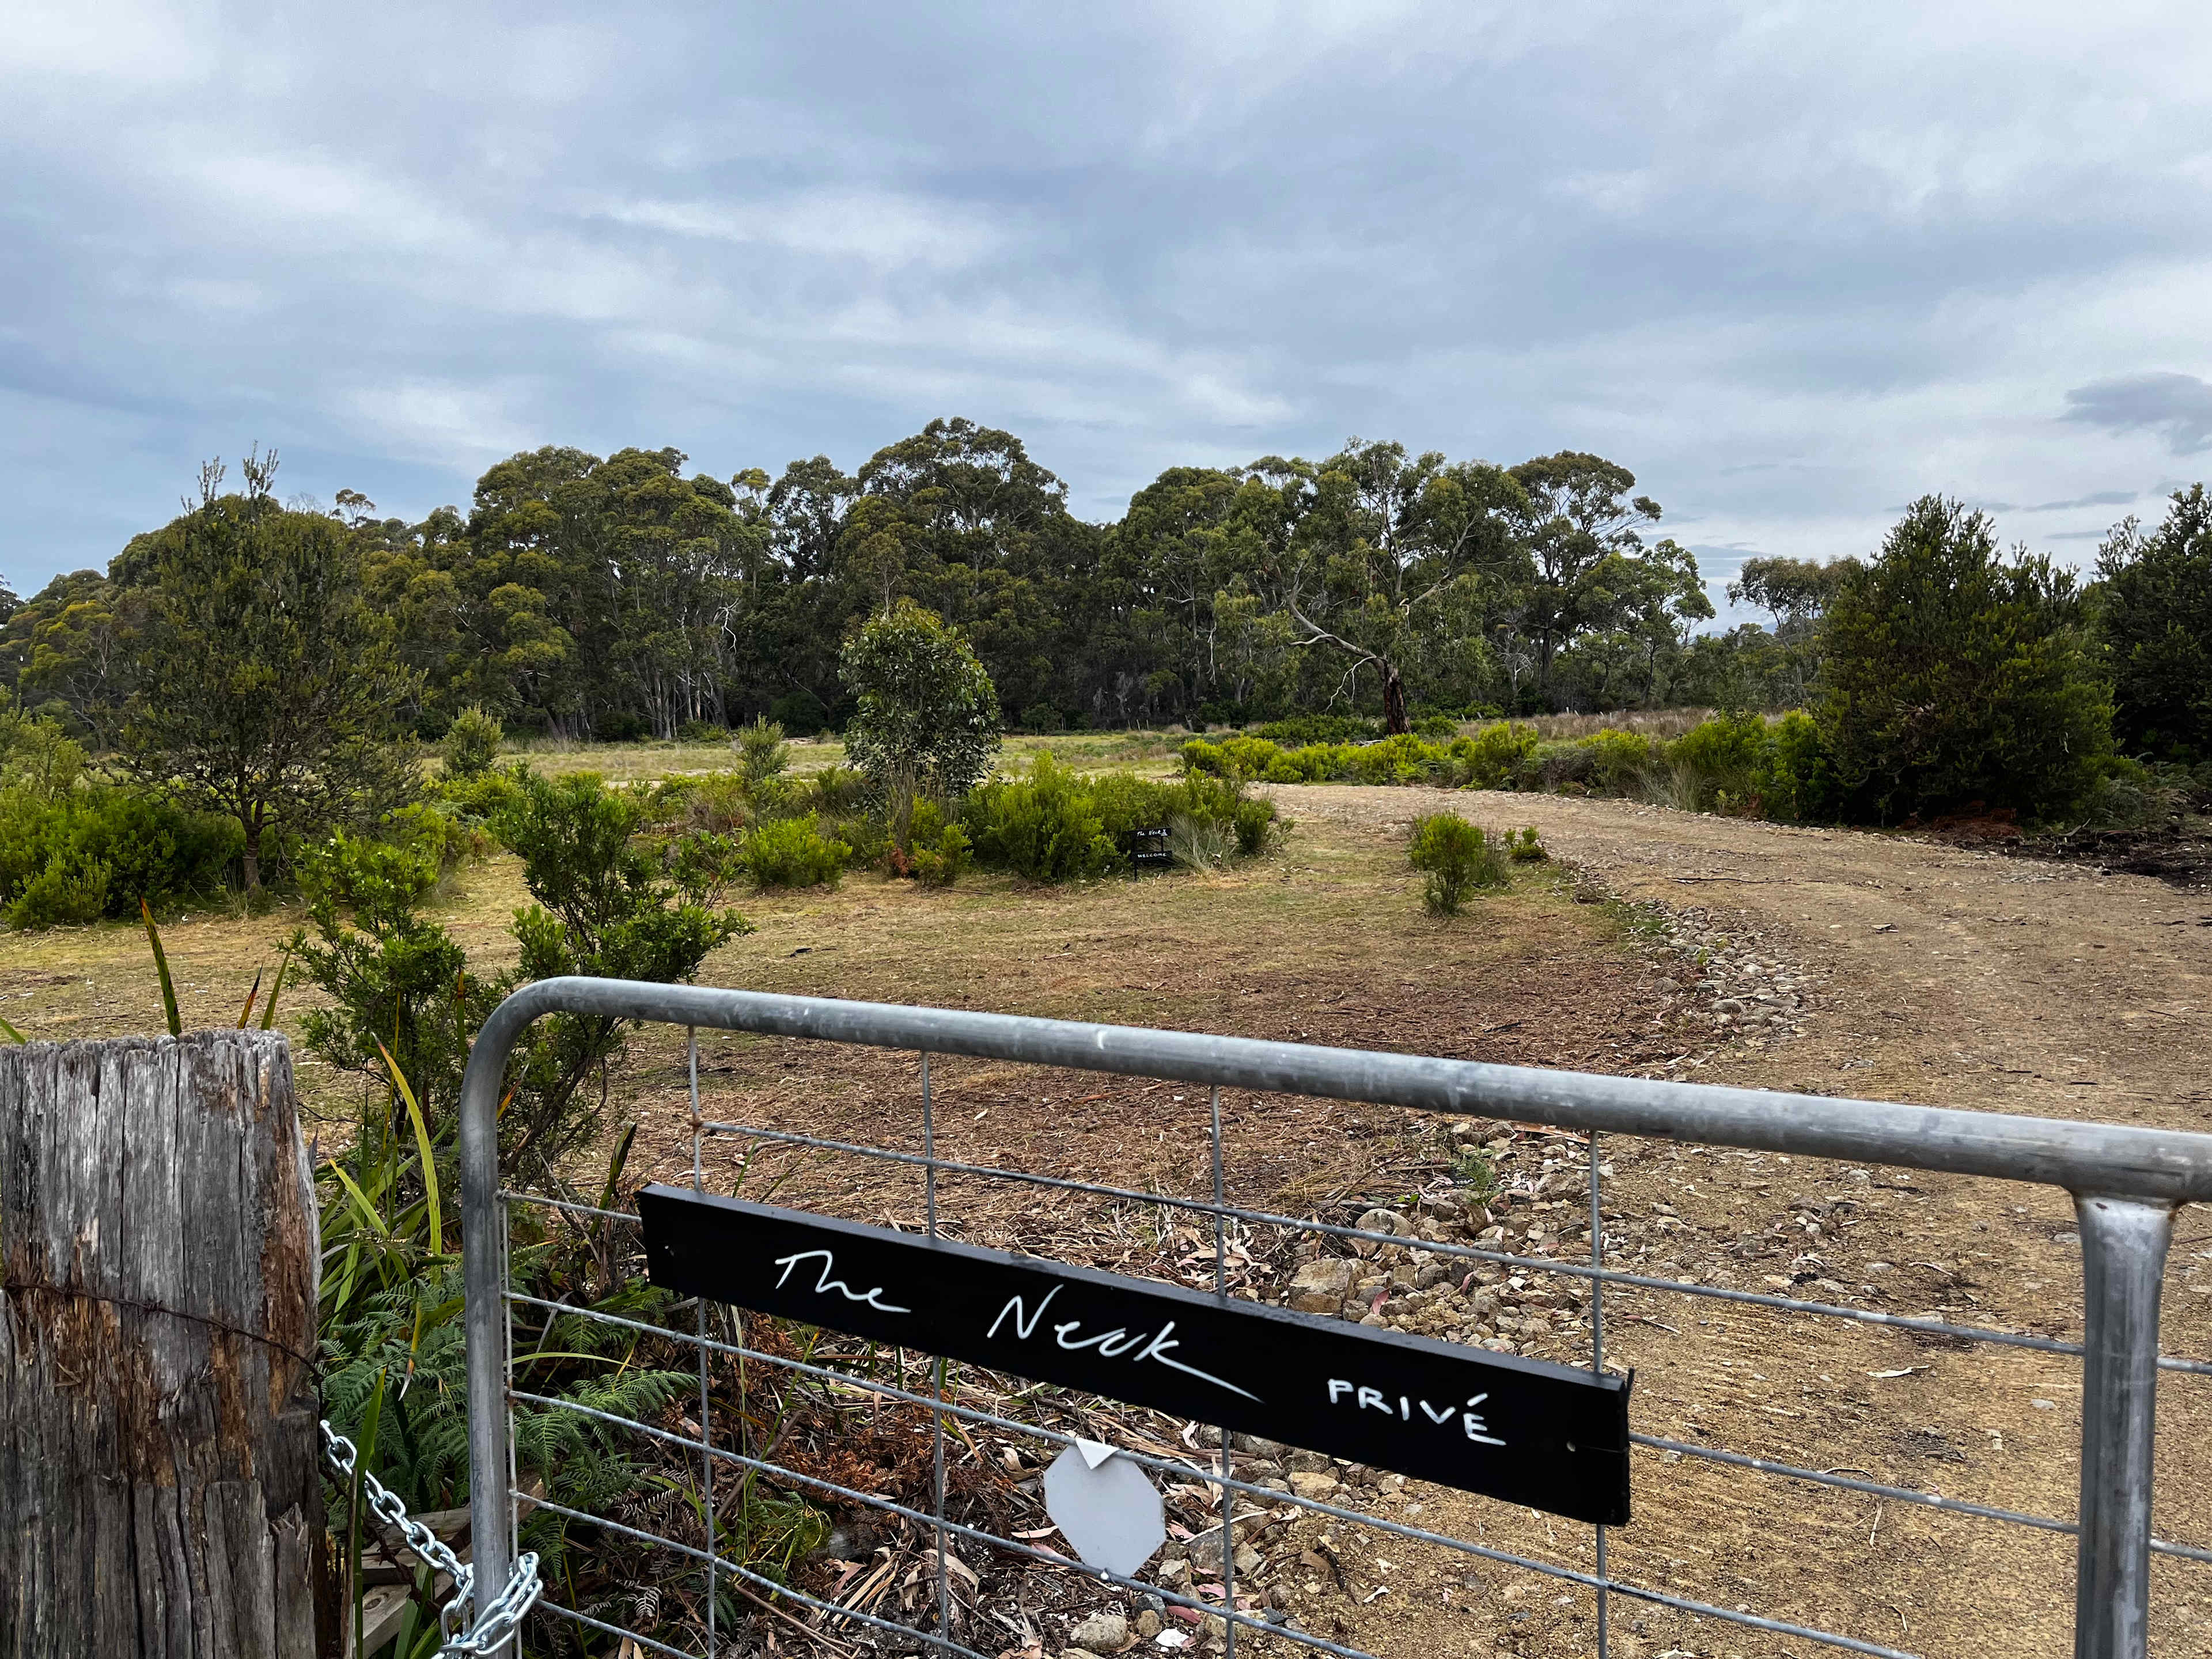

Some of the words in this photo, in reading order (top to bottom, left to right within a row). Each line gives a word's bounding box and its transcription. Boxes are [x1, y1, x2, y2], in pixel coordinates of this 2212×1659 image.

[775, 1249, 911, 1313] The
[986, 1283, 1266, 1404] Neck
[1327, 1378, 1506, 1446] PRIVÉ
